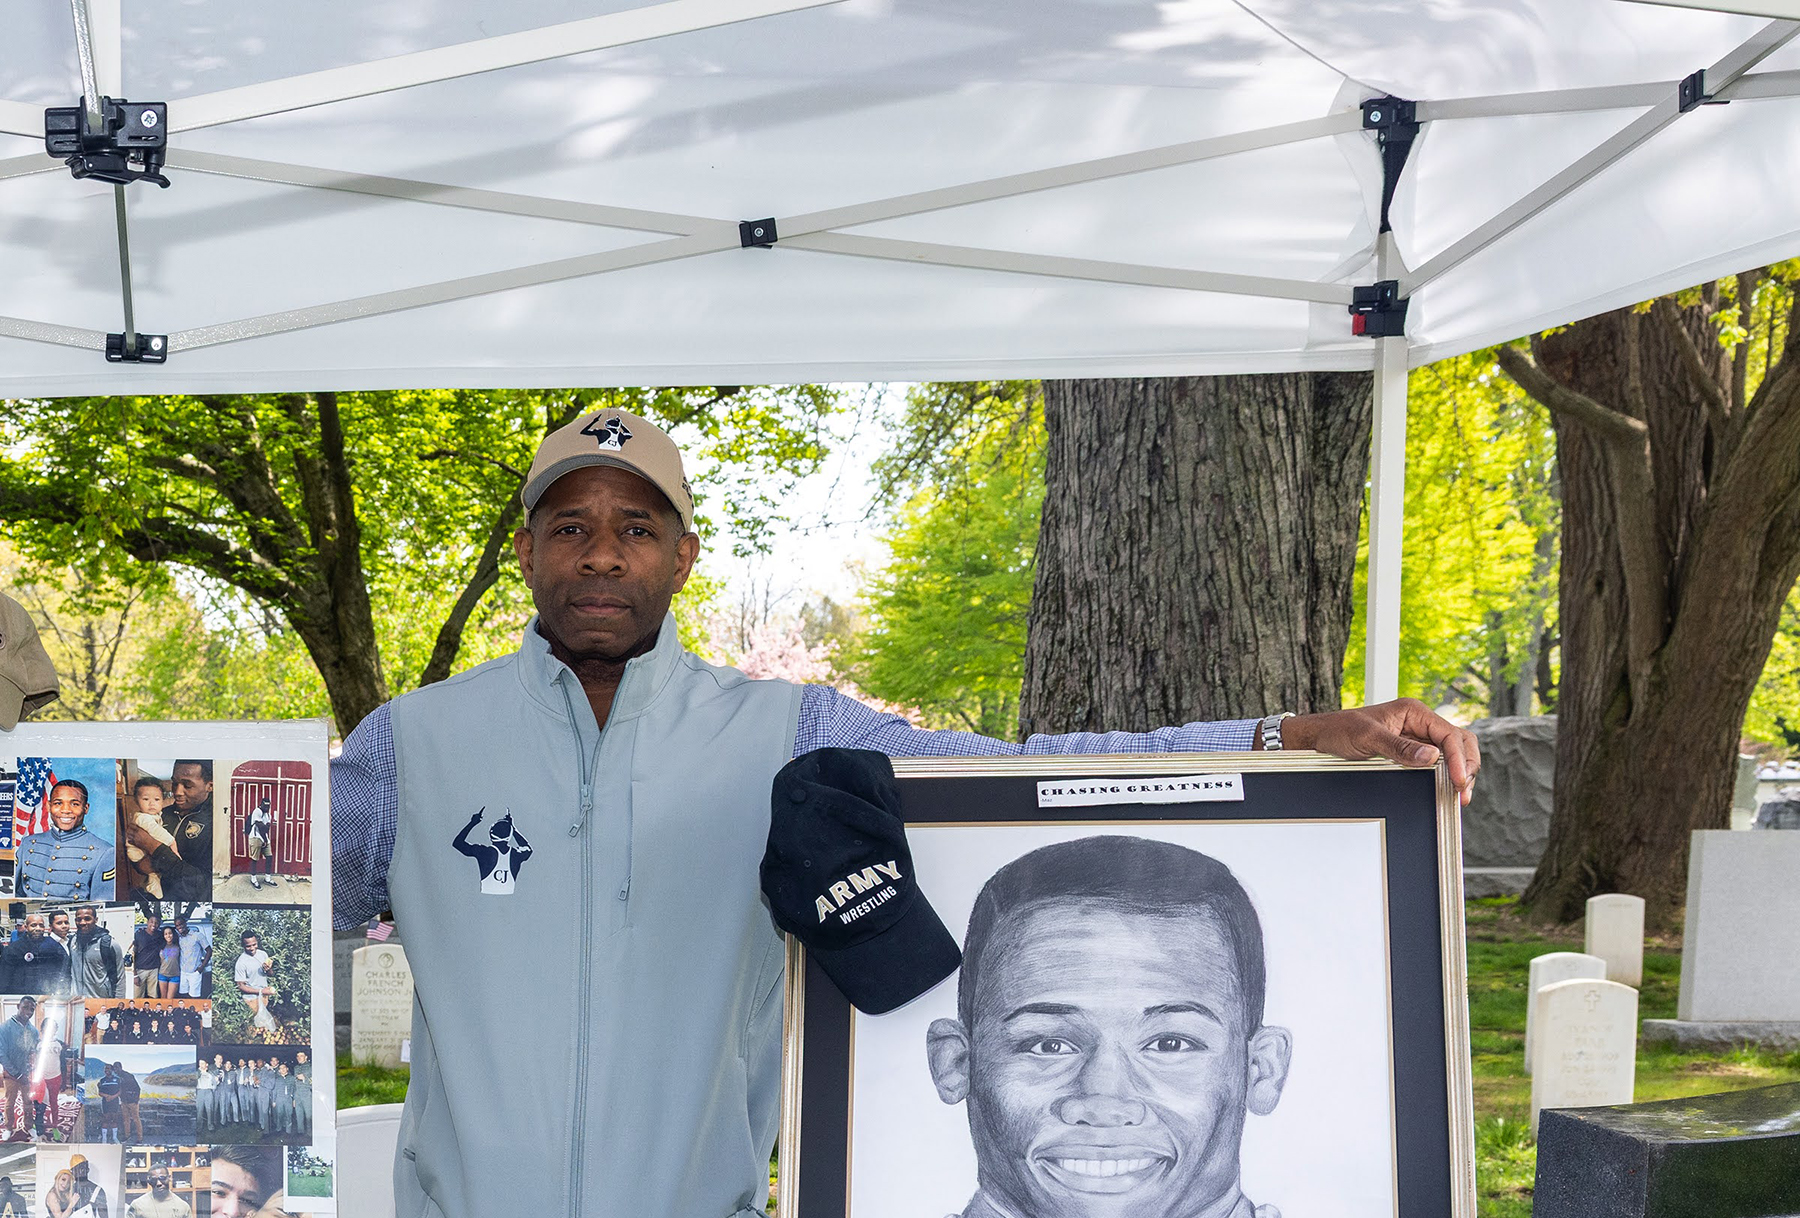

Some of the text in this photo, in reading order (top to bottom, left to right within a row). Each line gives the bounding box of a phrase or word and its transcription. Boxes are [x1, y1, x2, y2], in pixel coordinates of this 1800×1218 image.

[1041, 780, 1234, 796] CHASING GREATNESS
[493, 870, 509, 884] CJ
[815, 860, 902, 923] ARMY
[839, 885, 898, 925] WRESTLING
